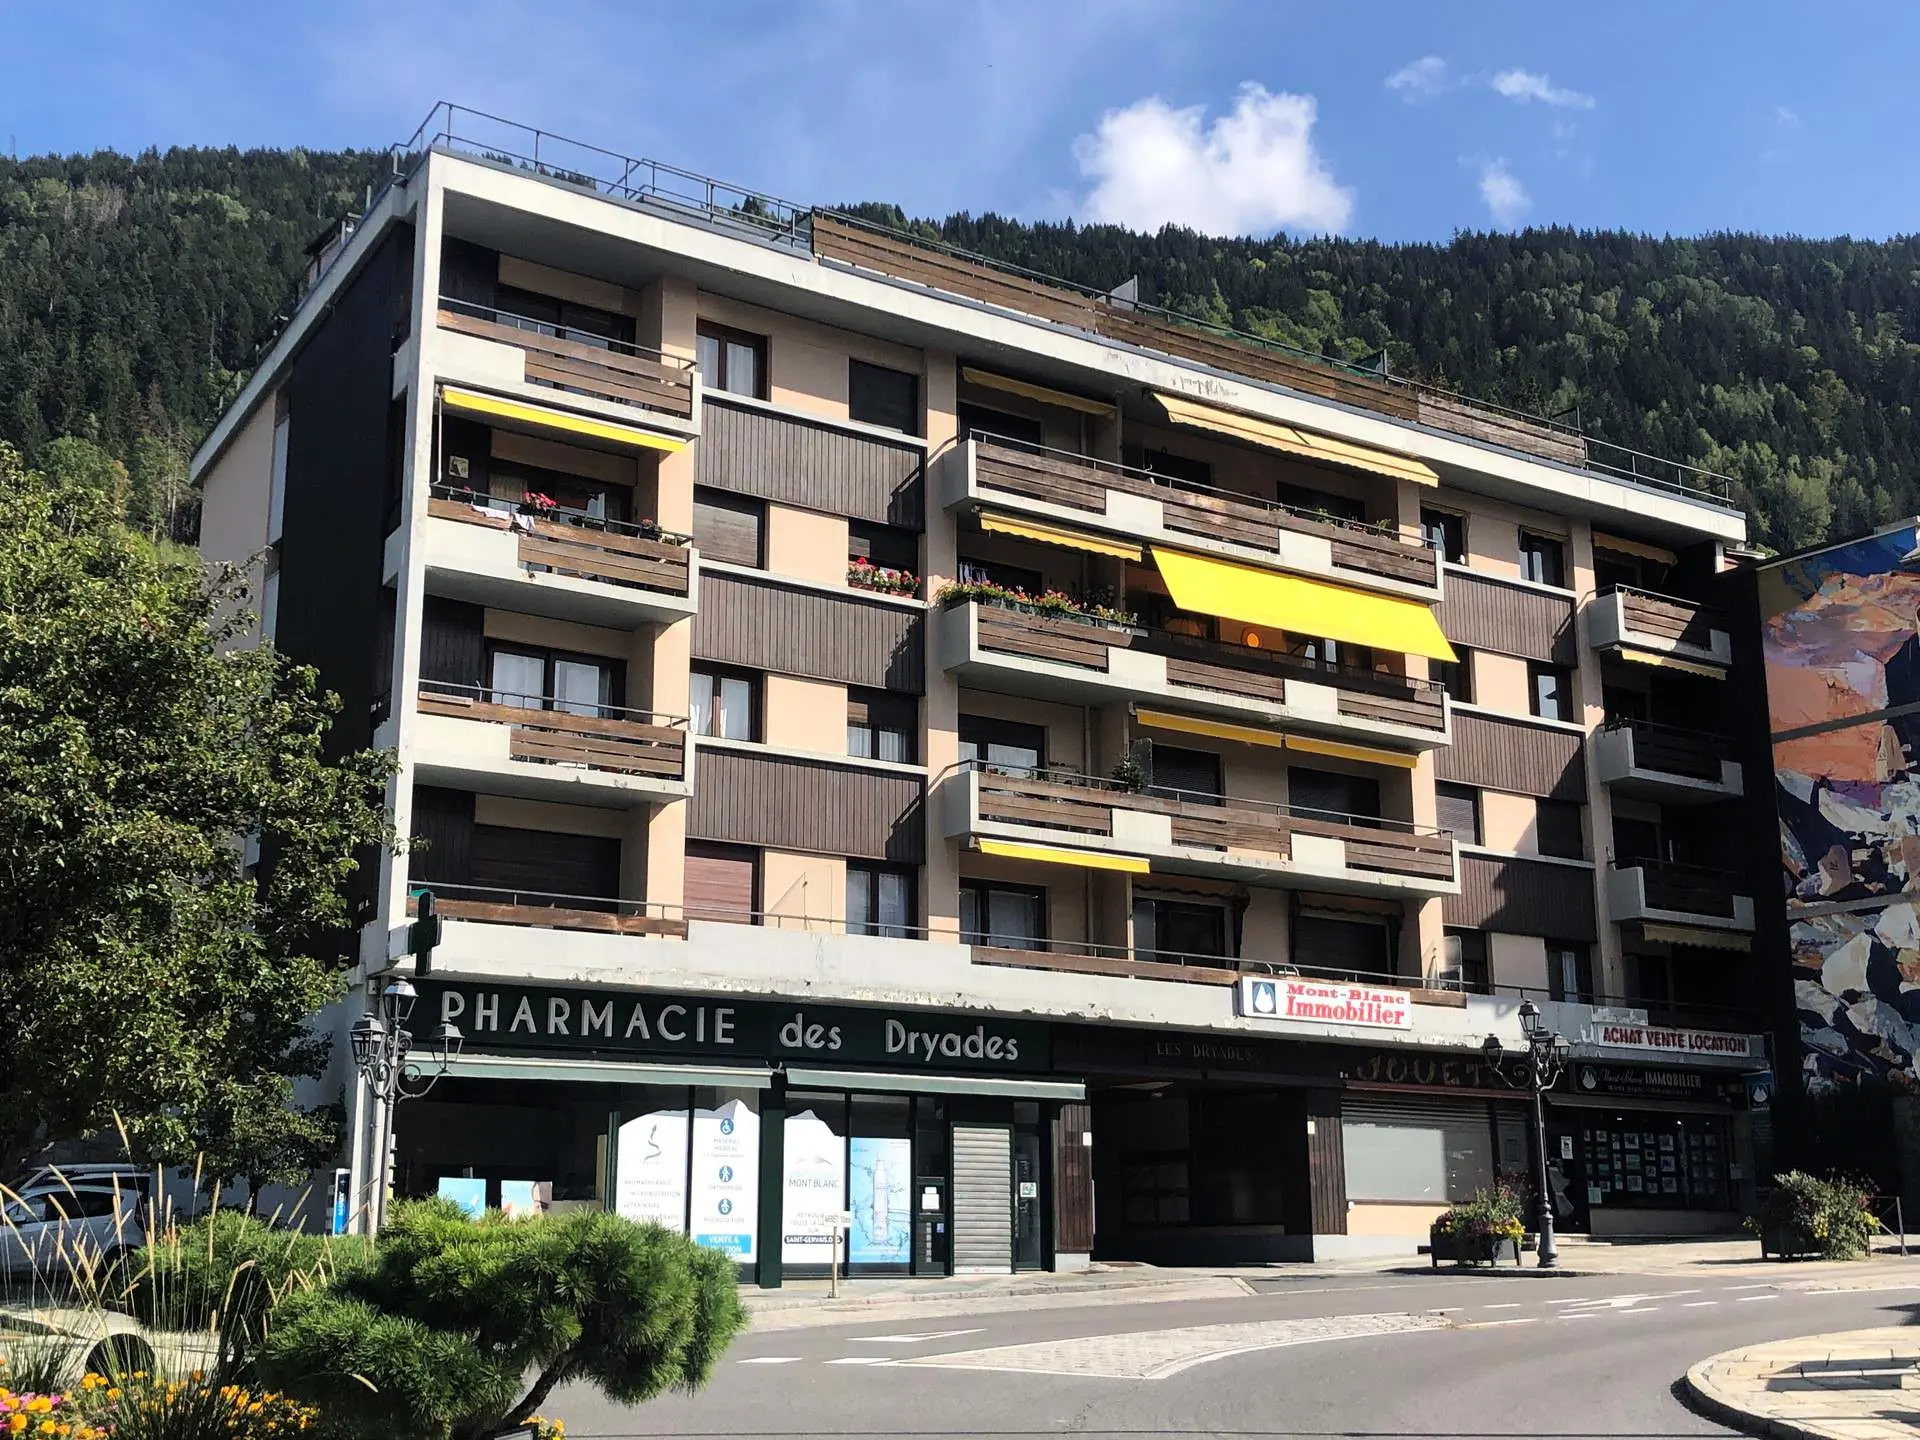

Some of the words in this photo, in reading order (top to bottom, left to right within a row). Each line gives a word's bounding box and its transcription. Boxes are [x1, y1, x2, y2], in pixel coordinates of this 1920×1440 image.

[1286, 983, 1405, 1005] Mont-Blanc
[1285, 996, 1405, 1025] Immobilier
[441, 991, 735, 1044] PHARMACIE
[779, 1012, 842, 1050] des
[885, 1019, 1019, 1061] Dryades
[1156, 1041, 1181, 1056] LES
[1193, 1044, 1253, 1061] DRYADES
[1603, 1027, 1642, 1044] ACHAT
[1646, 1031, 1685, 1048] VENTE
[1689, 1034, 1747, 1053] LOCATION
[1645, 1071, 1702, 1090] IMMOBILIER
[789, 1178, 811, 1187] MONT
[813, 1178, 840, 1188] BLANC
